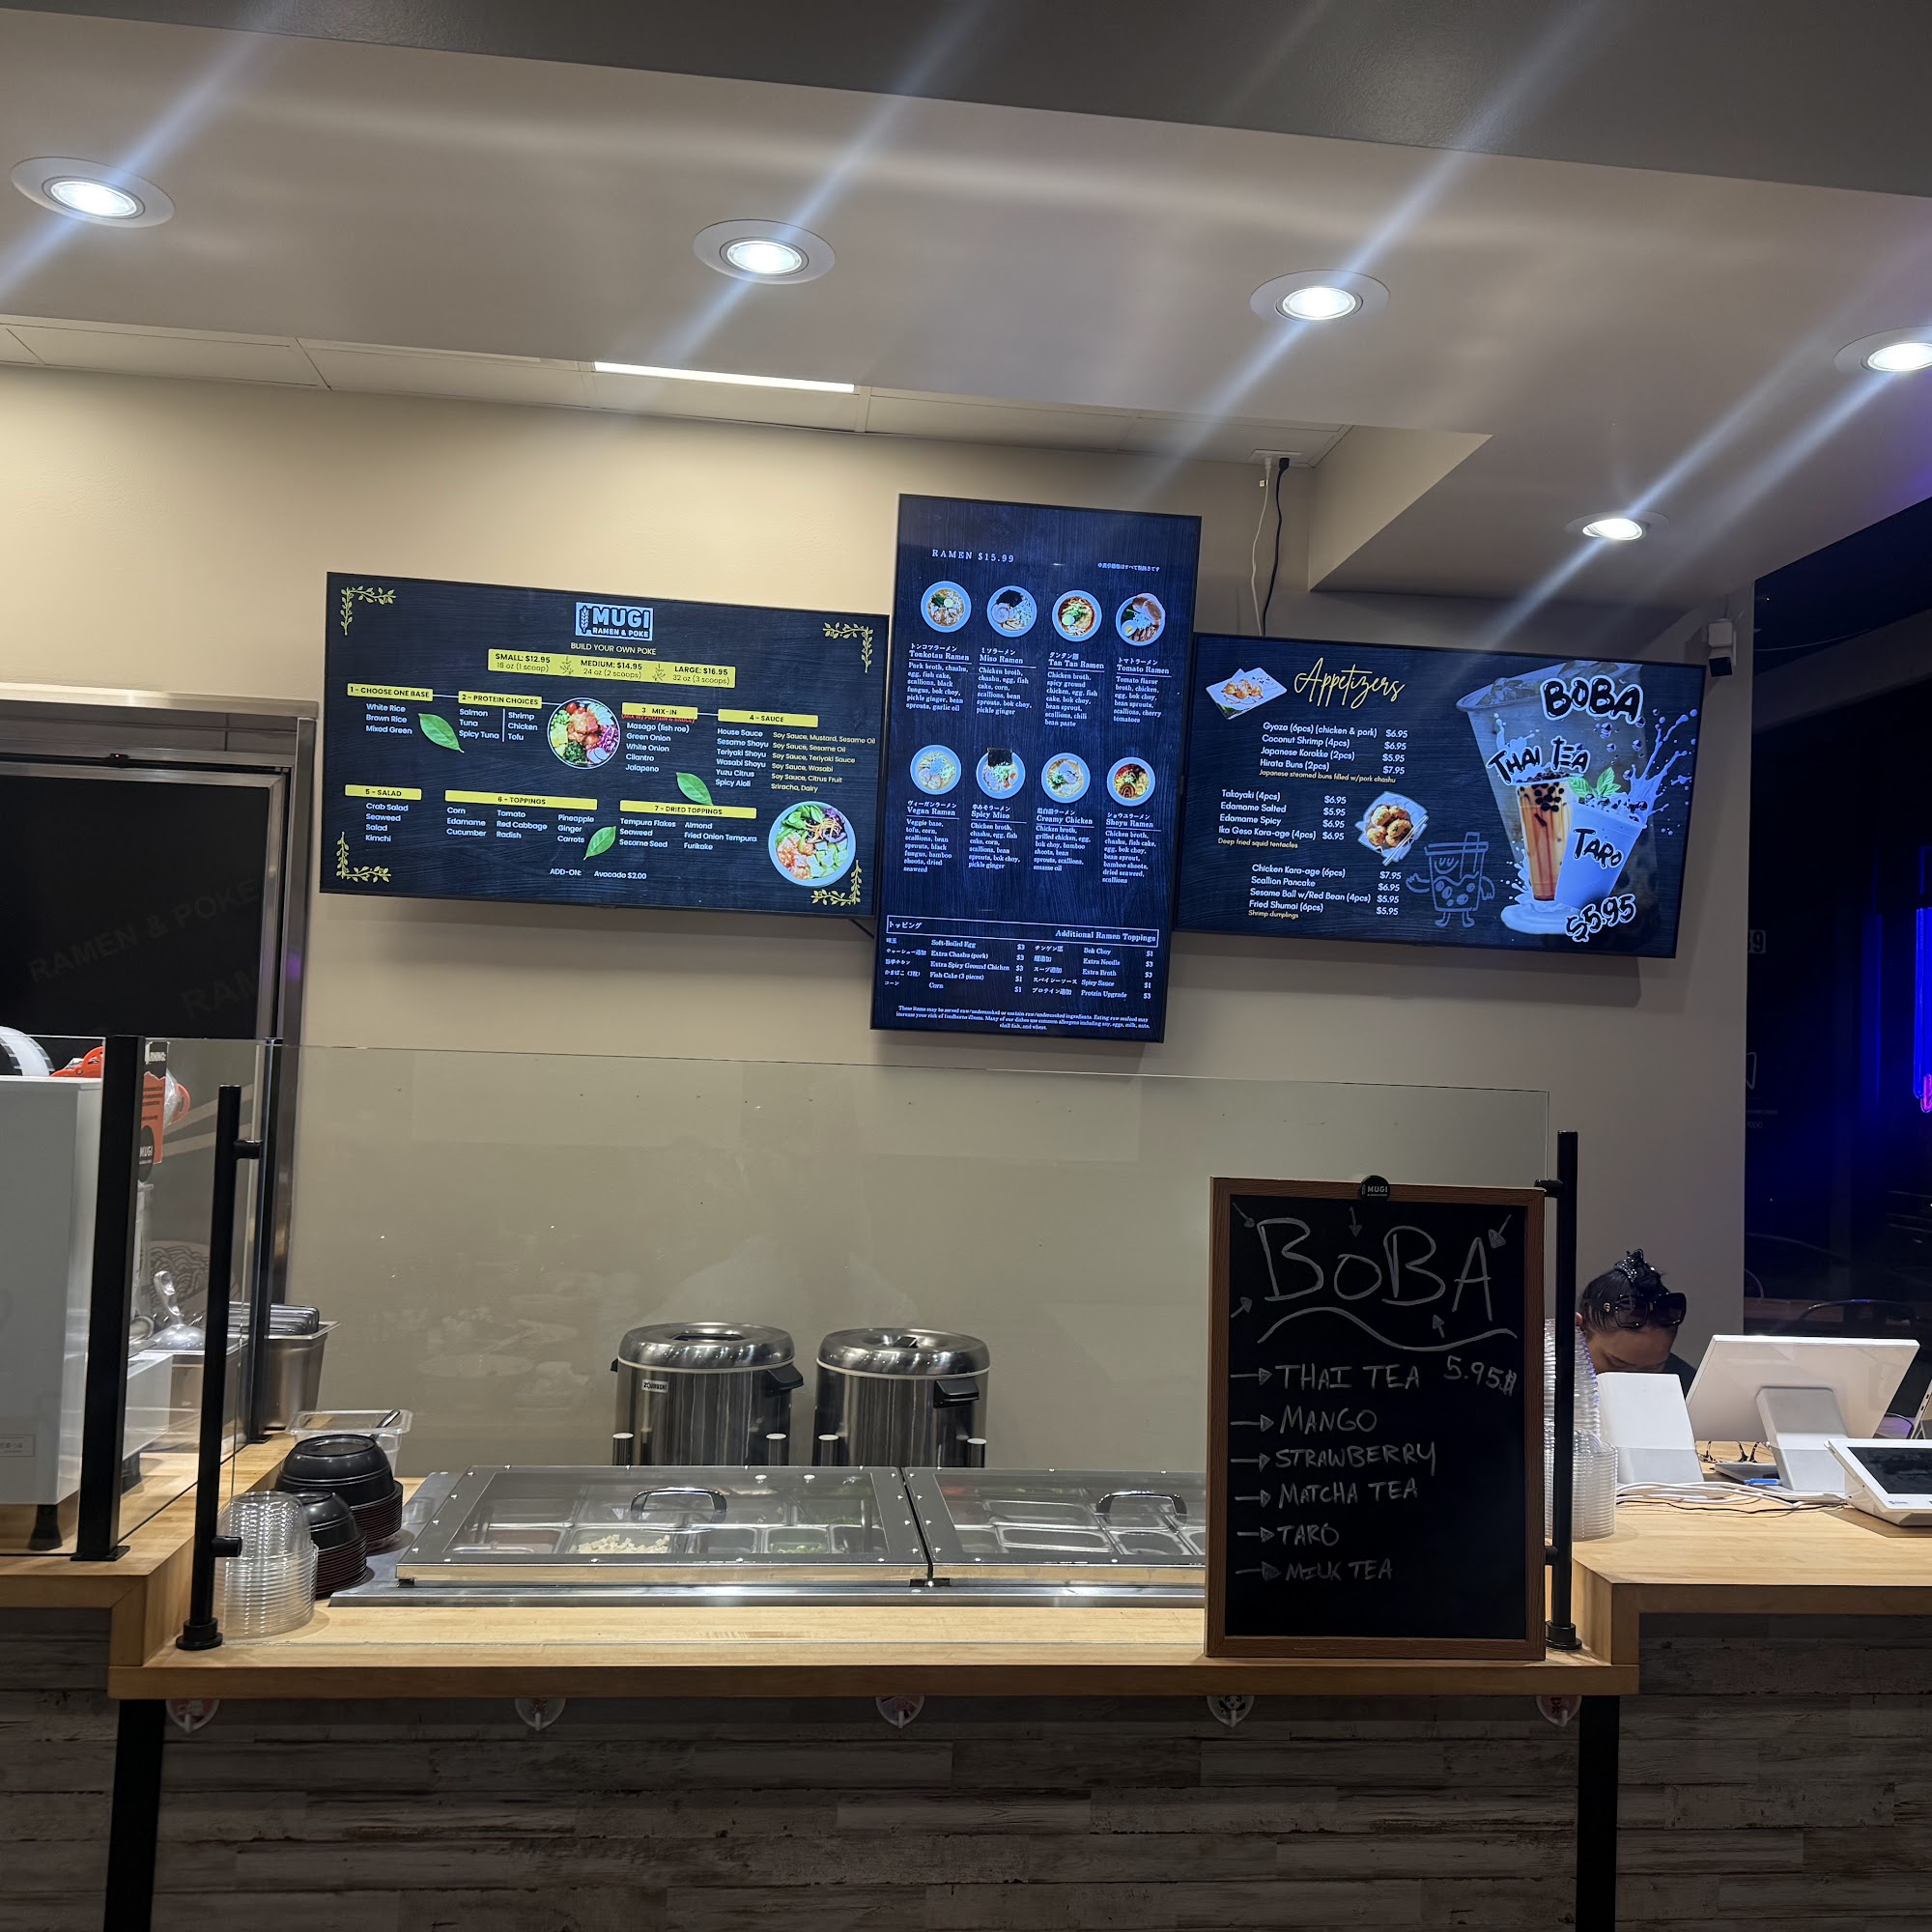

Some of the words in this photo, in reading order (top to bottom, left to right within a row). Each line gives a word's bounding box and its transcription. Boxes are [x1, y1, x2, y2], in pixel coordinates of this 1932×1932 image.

[932, 549, 973, 560] RAMEN
[979, 553, 1014, 562] $15.99
[592, 607, 648, 629] MUGI
[592, 627, 619, 636] RAMEN
[593, 643, 614, 652] YOUR
[495, 653, 524, 662] SMALL:
[526, 655, 551, 664] $12.95
[909, 650, 943, 659] Tonkotsu
[581, 660, 615, 668] MEDIUM:
[617, 662, 642, 670] $14.95
[674, 666, 701, 674] LARGE:
[1080, 661, 1104, 669] Ramen
[1146, 666, 1169, 674] Ramen
[1294, 658, 1405, 709] Appetizers
[360, 687, 392, 696] CHOOSE
[473, 695, 504, 703] PROTEIN
[505, 696, 539, 705] CHOICES
[1544, 678, 1641, 723] BOBA
[459, 708, 489, 717] Salmon
[508, 712, 534, 721] Shrimp
[366, 714, 387, 723] Brown
[389, 715, 407, 724] Rice
[459, 719, 478, 727] Tuna
[366, 724, 387, 733] Mixed
[388, 726, 412, 735] Green
[508, 722, 538, 730] Chicken
[1264, 723, 1288, 732] Gyoza
[1290, 724, 1314, 734] (6pcs)
[1316, 724, 1348, 735] (chicken
[1357, 727, 1377, 737] pork)
[1385, 729, 1407, 738] $6.95
[459, 730, 479, 739] Spicy
[480, 731, 499, 740] Tuna
[626, 743, 646, 752] White
[1263, 735, 1295, 744] Coconut
[1296, 736, 1323, 747] Shrimp
[1325, 738, 1350, 748] (4pcs)
[1384, 742, 1406, 751] $6.95
[1261, 747, 1297, 756] Japanese
[1299, 749, 1328, 758] Korokke
[1330, 751, 1354, 760] (2pcs)
[1382, 753, 1405, 762] $5.95
[1488, 746, 1543, 784] THAI
[1551, 736, 1589, 772] TEA
[625, 764, 659, 773] Jalapeno
[1260, 759, 1284, 768] Hirata
[1286, 760, 1303, 769] Buns
[1305, 761, 1329, 771] (2pcs)
[1383, 766, 1405, 775] $7.95
[510, 797, 546, 806] TOPPINGS
[1222, 789, 1254, 799] Takoyaki
[1256, 791, 1280, 802] (4pcs)
[1324, 795, 1346, 805] $6.95
[1221, 802, 1259, 811] Edamame
[1262, 804, 1286, 812] Salted
[497, 810, 526, 818] Tomato
[558, 814, 594, 823] Pineapple
[513, 822, 548, 831] Cabbage
[1106, 818, 1128, 827] Shoyu
[1220, 814, 1258, 823] Edamame
[1261, 816, 1281, 826] Spicy
[1322, 819, 1345, 829] $6.95
[557, 825, 582, 834] Ginger
[1219, 826, 1230, 835] Ika
[1232, 826, 1252, 836] Geso
[1254, 828, 1290, 838] Kara-age
[1292, 830, 1316, 839] (4pcs)
[1322, 832, 1345, 840] $6.95
[1574, 828, 1622, 868] TARO
[1252, 864, 1283, 873] Chicken
[1285, 866, 1321, 877] Kara-age
[1322, 867, 1346, 877] (6pcs)
[1379, 870, 1401, 880] $7.95
[1251, 876, 1281, 886] Scallion
[1283, 878, 1316, 888] Pancake
[1378, 883, 1400, 892] $6.95
[1250, 888, 1280, 897] Sesame
[1282, 890, 1296, 898] Ball
[1298, 891, 1323, 900] w/Red
[1325, 893, 1345, 901] Bean
[1347, 893, 1371, 903] (4pcs)
[1377, 895, 1399, 903] $5.95
[1249, 900, 1268, 909] Fried
[1270, 901, 1298, 910] Shumai
[1300, 902, 1323, 913] (6pcs)
[1377, 906, 1399, 915] $5.95
[1566, 895, 1635, 942] $5.95
[1056, 929, 1094, 938] Additional
[1095, 931, 1121, 940] Ramen
[1122, 933, 1155, 942] Toppings
[1275, 1365, 1352, 1390] THAI
[1363, 1365, 1420, 1389] TEA
[1280, 1406, 1377, 1434] MANGO
[1276, 1441, 1435, 1476] STRAWBERRY
[1279, 1484, 1358, 1509] MATCHA
[1370, 1478, 1418, 1499] TEA
[1277, 1523, 1339, 1546] TARO
[1348, 1558, 1393, 1579] TEA
